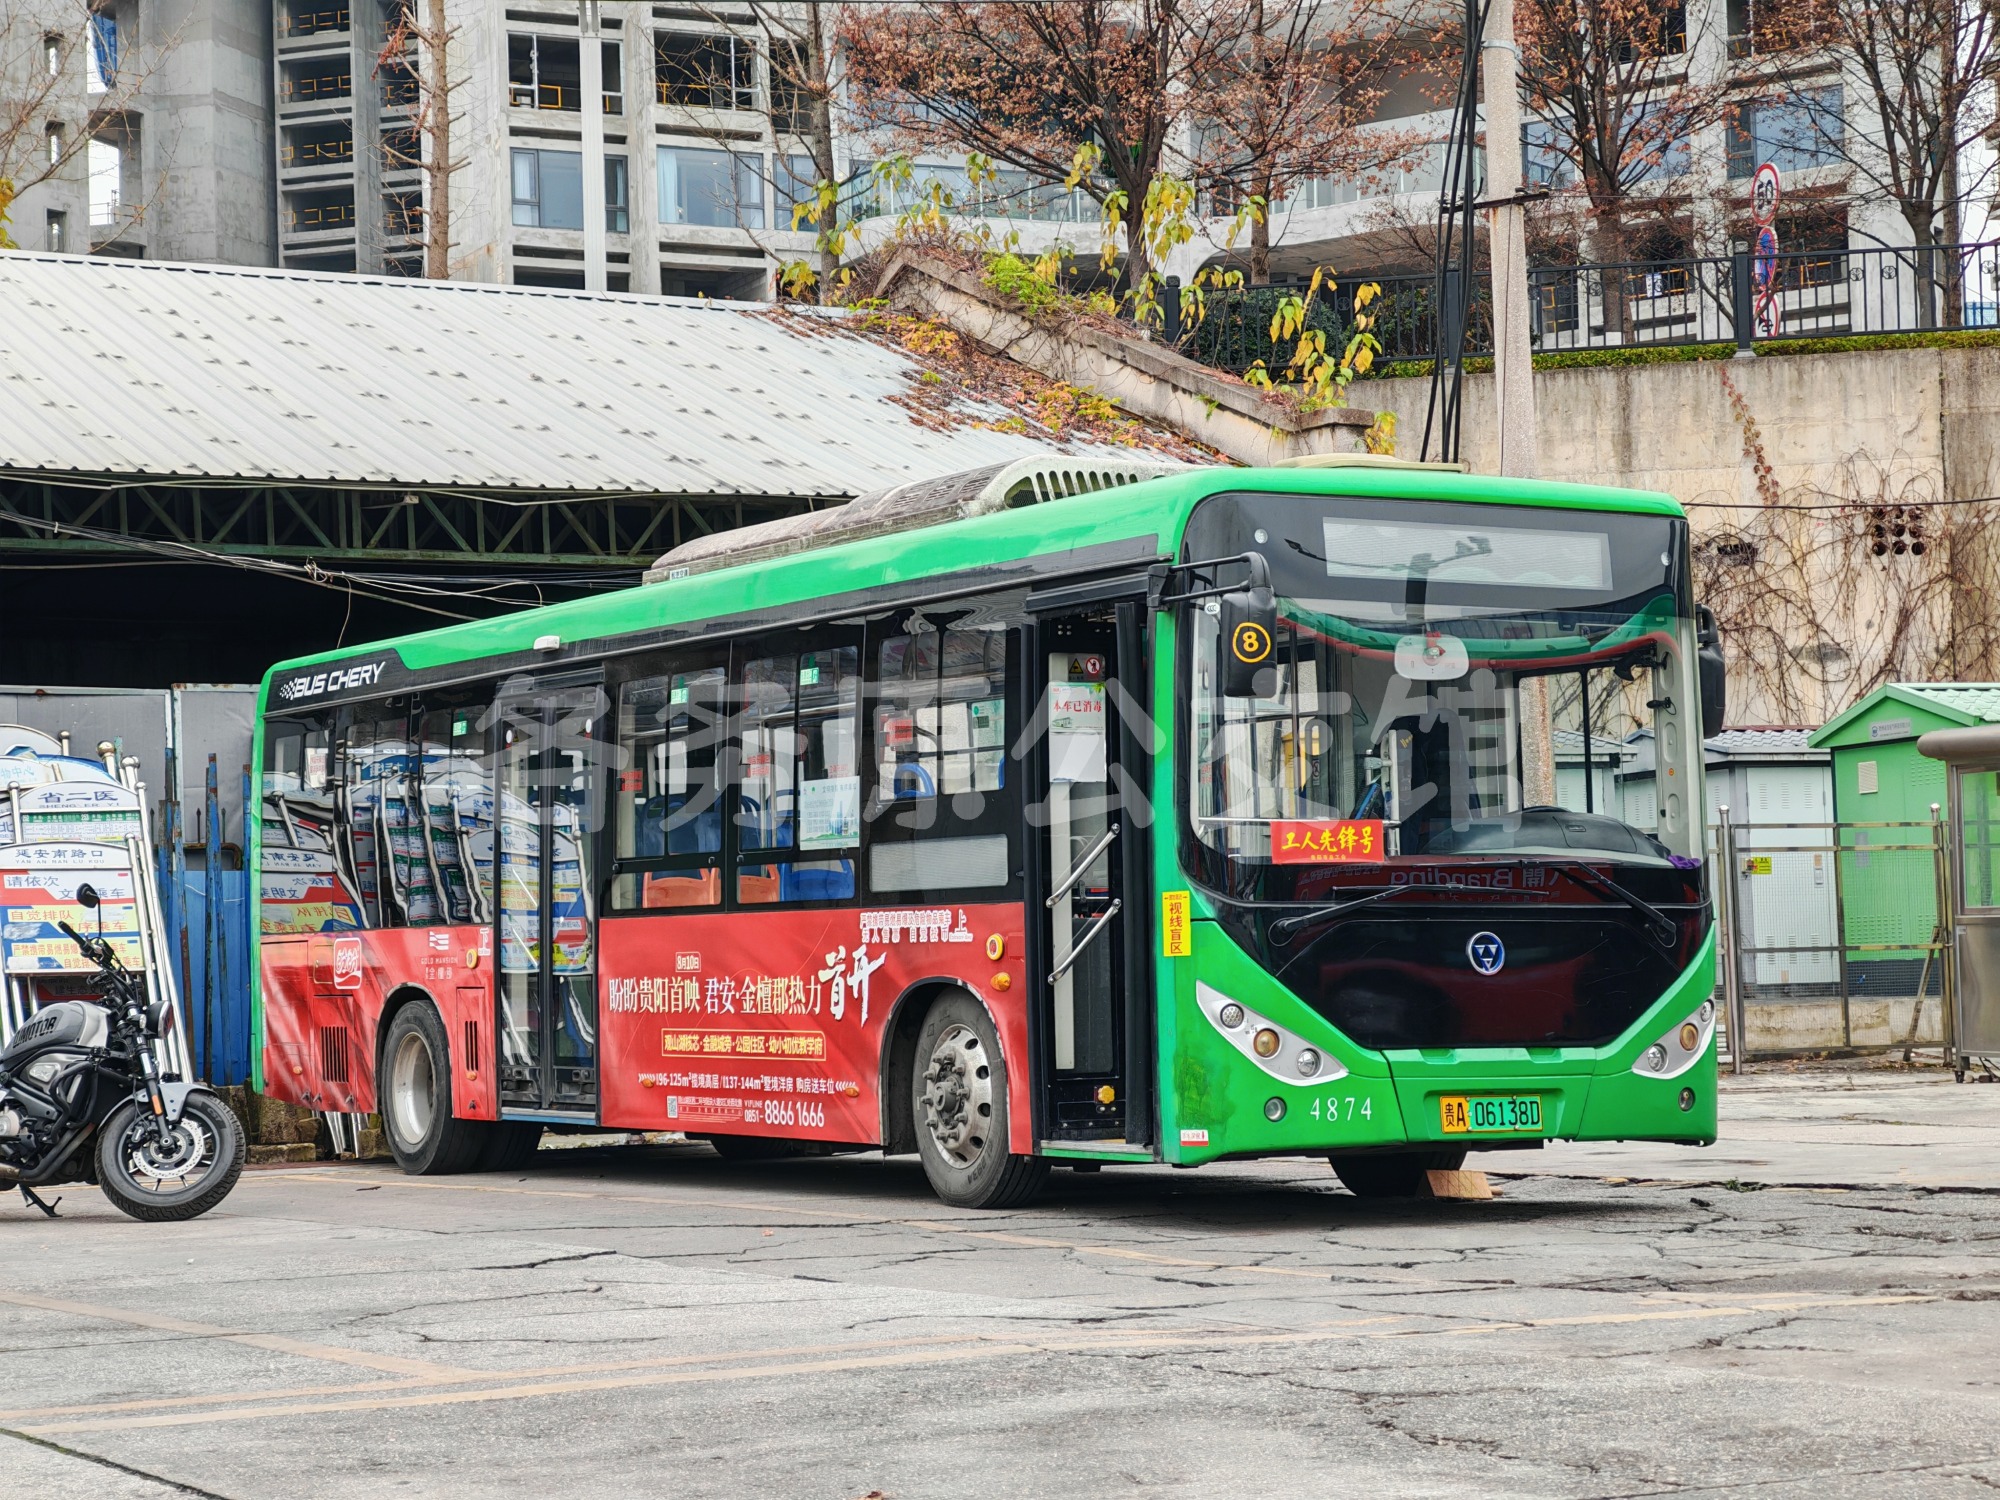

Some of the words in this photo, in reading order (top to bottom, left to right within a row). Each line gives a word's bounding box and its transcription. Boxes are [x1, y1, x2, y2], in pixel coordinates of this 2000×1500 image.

[1242, 631, 1259, 652] 8
[293, 673, 326, 698] BUS
[327, 661, 386, 692] CHERY
[1053, 699, 1102, 713] 本车已消毒
[38, 790, 119, 804] 省二医
[1281, 825, 1374, 854] 工人先锋号
[15, 848, 104, 859] 延安南路口
[7, 875, 60, 887] 请依次
[58, 888, 126, 900] 文乘车
[11, 910, 74, 921] 自觉排队
[955, 908, 968, 933] 上
[1169, 902, 1183, 954] 视线盲区
[676, 955, 700, 970] 8月10日
[608, 976, 700, 1014] 盼盼贵阳首映
[796, 1077, 835, 1094] 购房送车位
[764, 1099, 794, 1126] 8866
[796, 1102, 825, 1128] 1666
[1310, 1096, 1373, 1121] 4874
[1443, 1101, 1542, 1128] 贵A06138D
